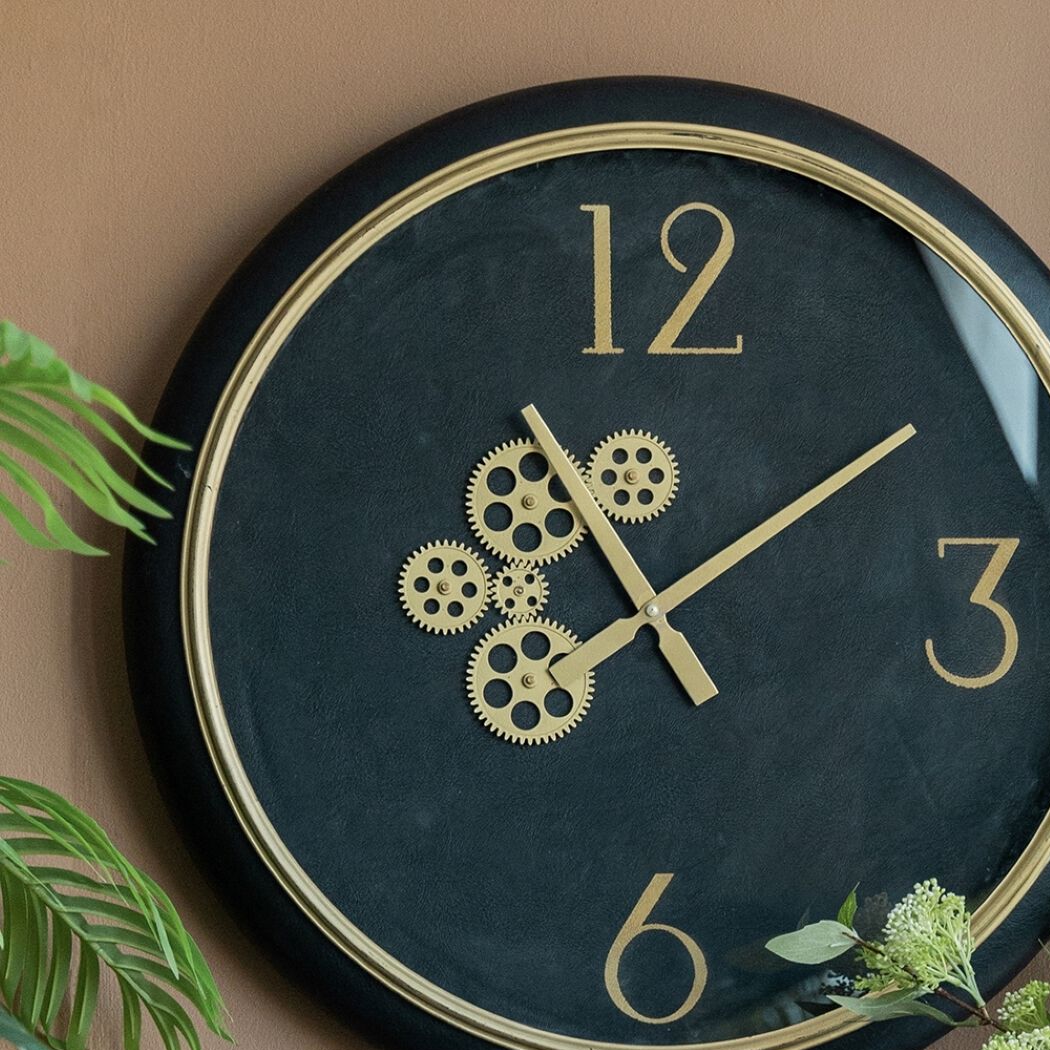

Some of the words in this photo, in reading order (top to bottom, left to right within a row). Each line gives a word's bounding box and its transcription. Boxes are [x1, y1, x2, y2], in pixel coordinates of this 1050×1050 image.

[579, 201, 744, 356] 12
[924, 537, 1020, 690] 3
[604, 873, 708, 1025] 6
